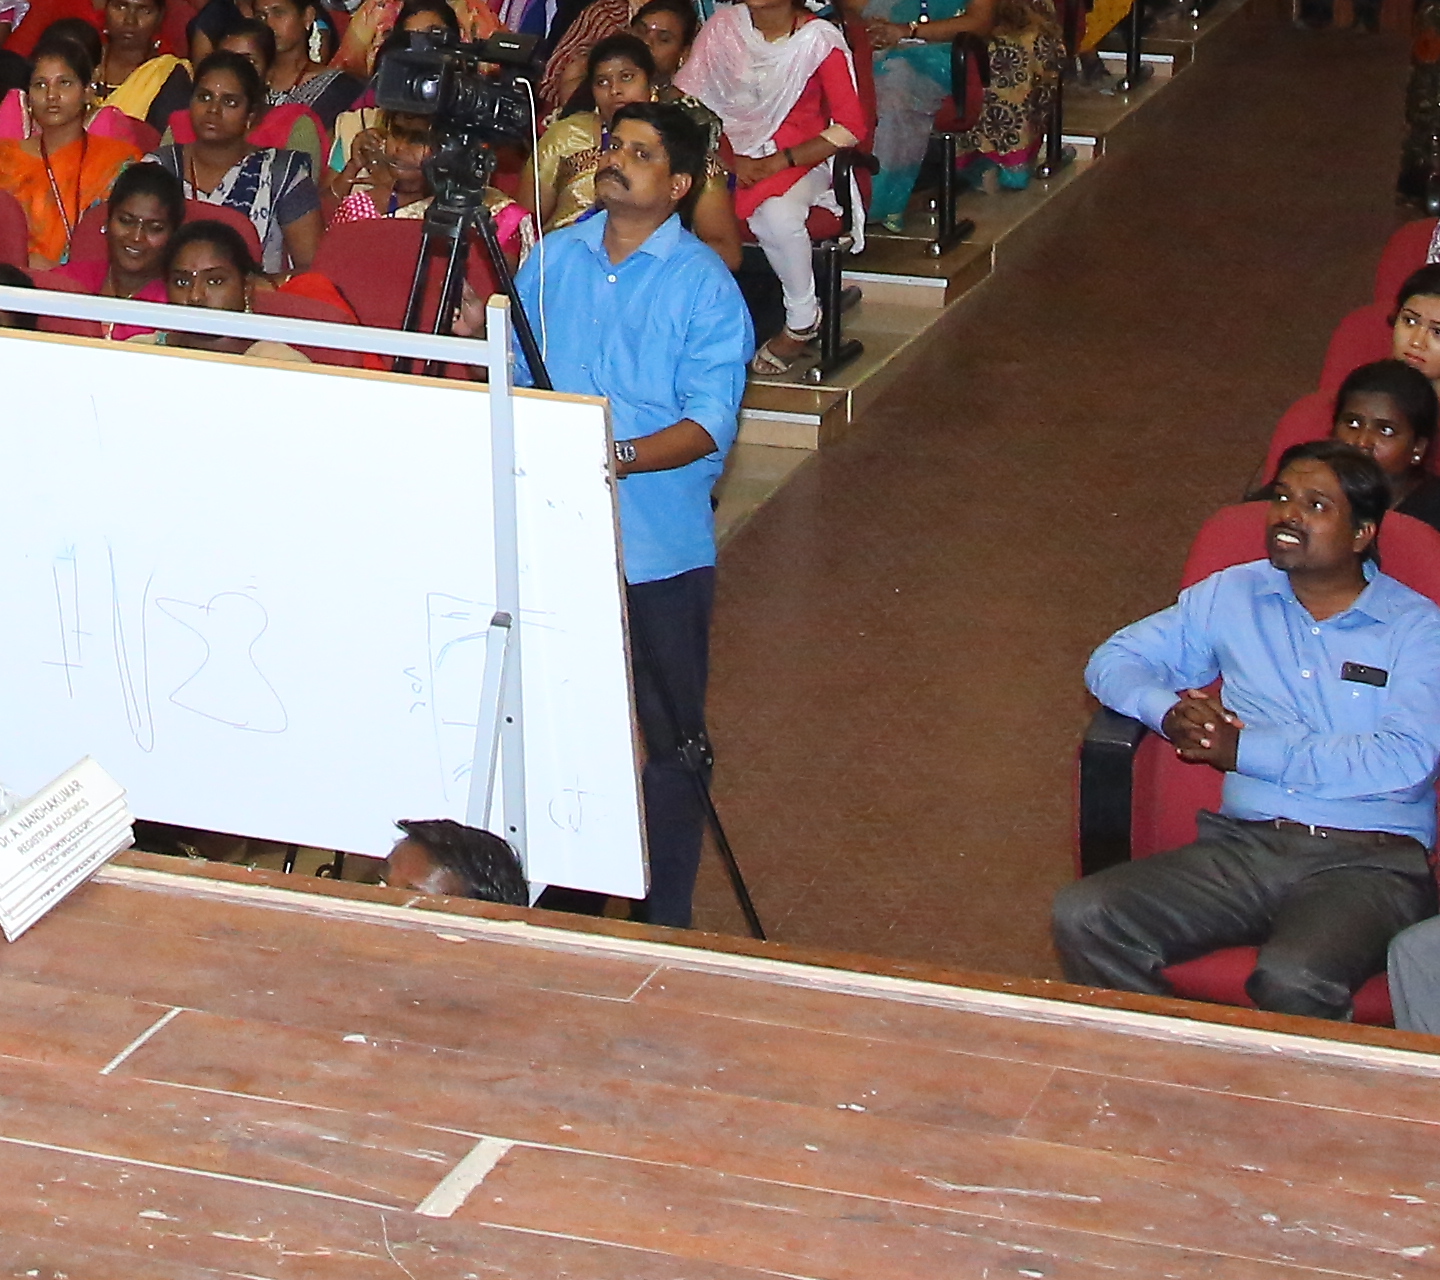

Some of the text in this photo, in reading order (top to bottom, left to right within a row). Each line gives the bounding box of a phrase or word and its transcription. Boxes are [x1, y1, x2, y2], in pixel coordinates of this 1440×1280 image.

[9, 826, 22, 839] A.
[18, 779, 84, 831] NANDHAKUMAR
[17, 798, 89, 855] REGISTRAR ACADEMICS
